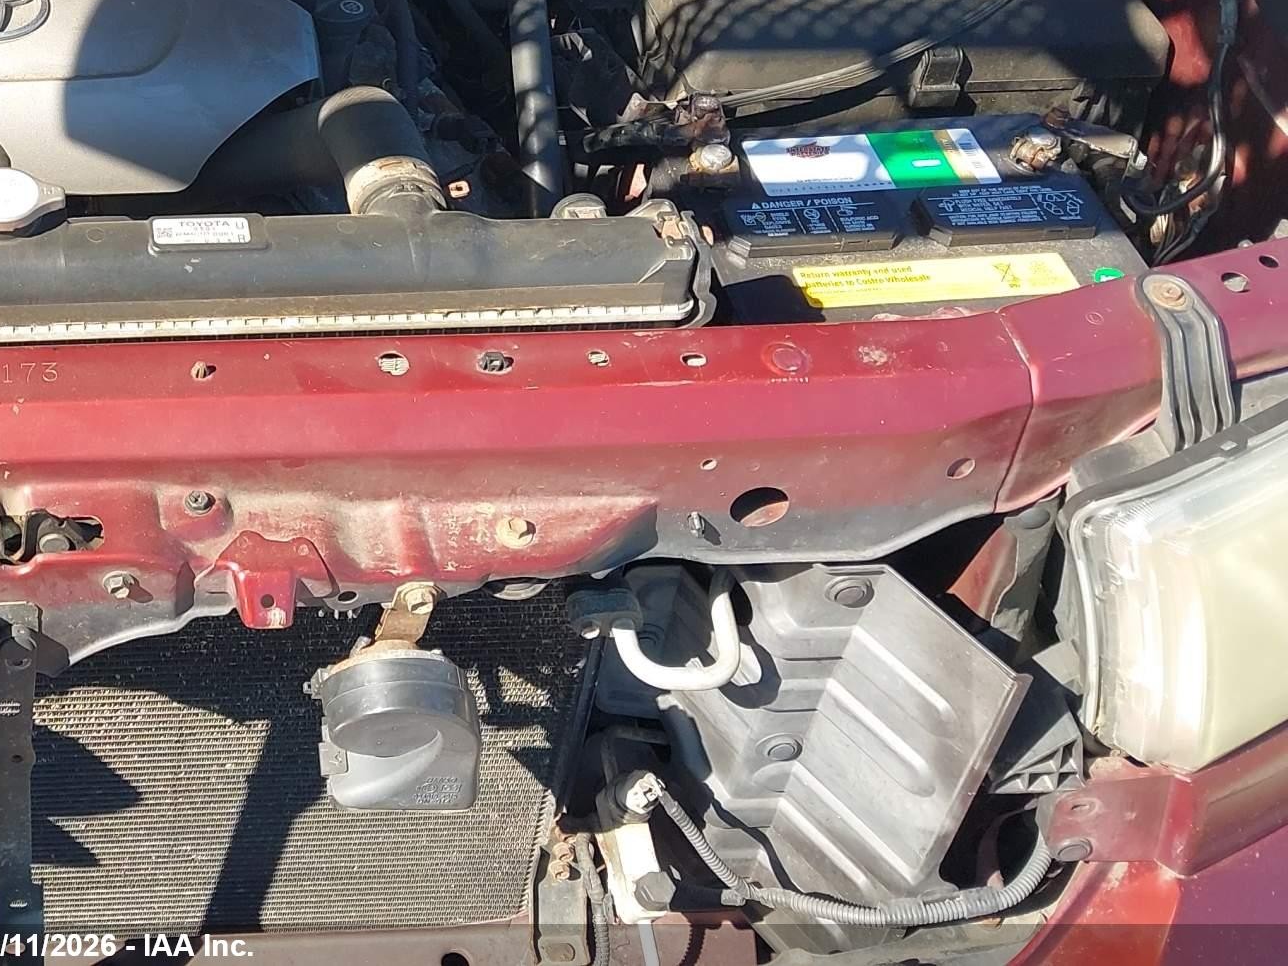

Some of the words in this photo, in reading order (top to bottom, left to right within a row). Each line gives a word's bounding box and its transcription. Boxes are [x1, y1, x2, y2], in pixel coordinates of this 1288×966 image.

[762, 200, 804, 209] DANGER
[813, 196, 853, 206] POISON
[800, 271, 830, 279] Return
[833, 268, 871, 277] warranty
[891, 265, 913, 273] used
[804, 280, 843, 288] batteries
[885, 274, 931, 284] Wholesale
